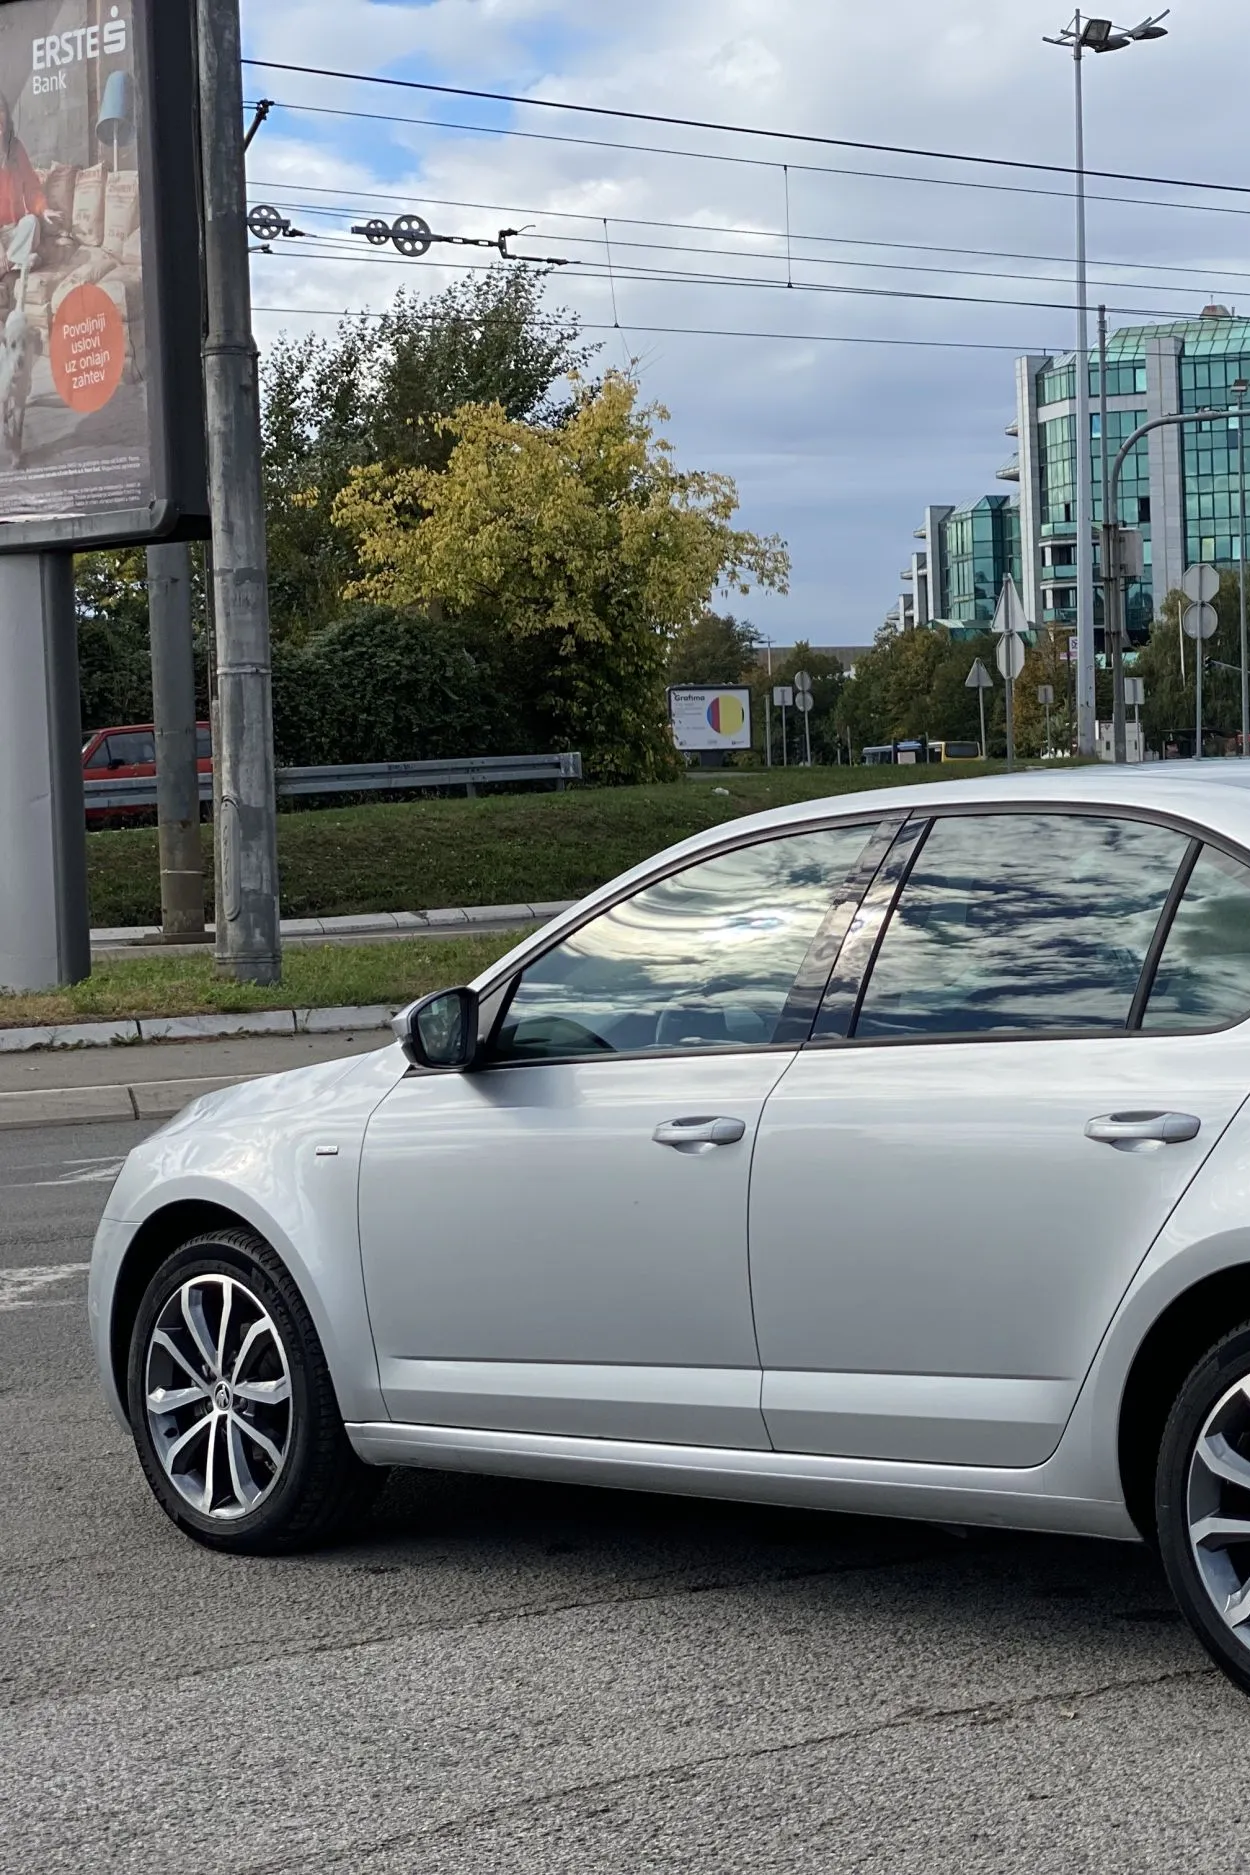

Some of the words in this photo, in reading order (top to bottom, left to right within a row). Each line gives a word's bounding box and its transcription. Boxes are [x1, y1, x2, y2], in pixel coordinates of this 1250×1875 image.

[32, 25, 100, 70] ERSTE
[32, 70, 67, 95] Bank
[63, 312, 106, 340] Povoljniji
[71, 331, 101, 354] uslovi
[65, 359, 77, 374] uz
[79, 349, 110, 369] onlajn
[72, 368, 105, 389] zahtev
